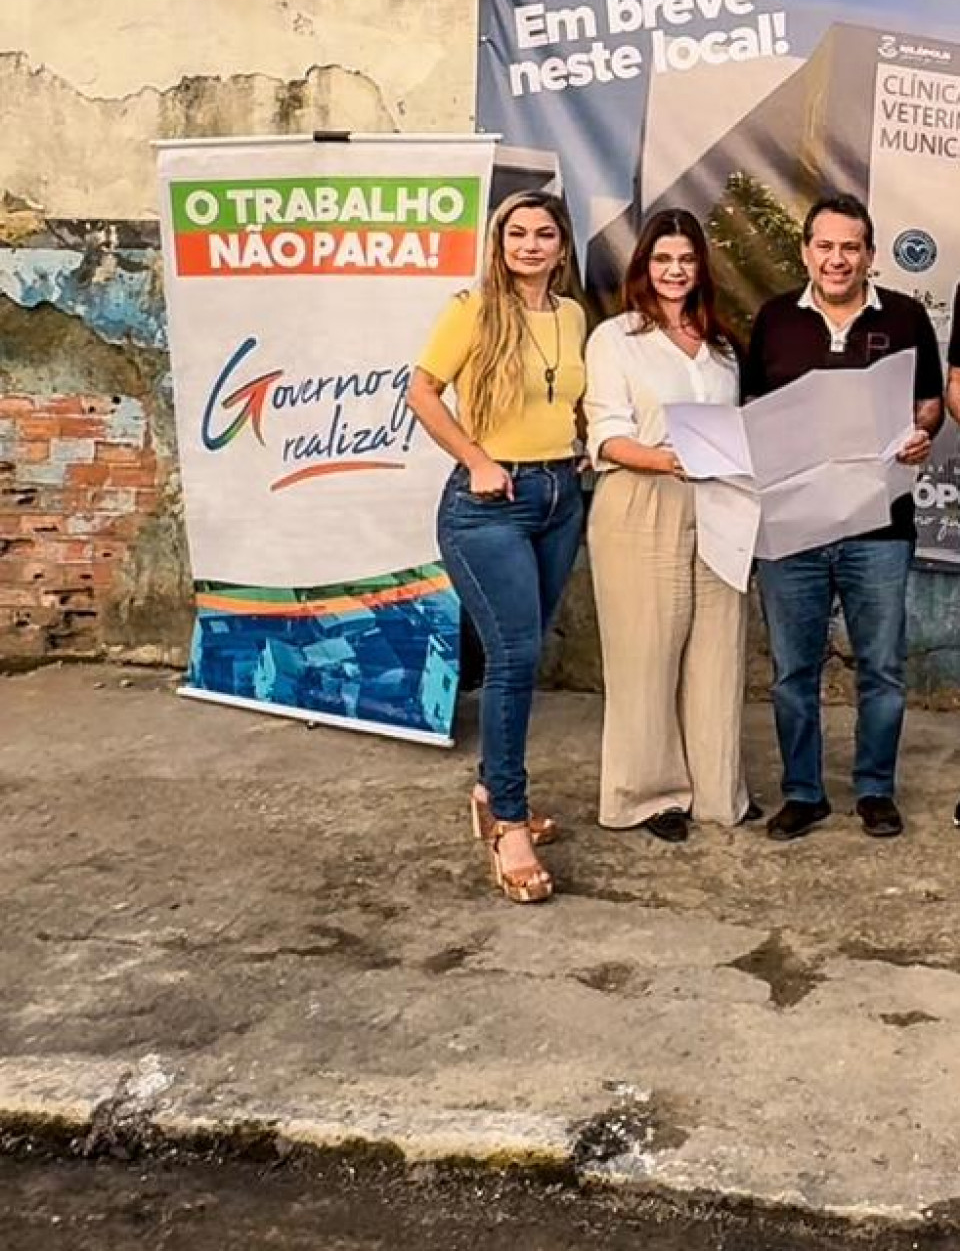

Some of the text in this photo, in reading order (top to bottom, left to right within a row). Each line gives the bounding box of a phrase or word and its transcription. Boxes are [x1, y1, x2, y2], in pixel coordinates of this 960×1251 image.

[514, 3, 597, 48] Em
[509, 12, 790, 97] neste local!
[185, 186, 465, 225] O TRABALHO
[208, 224, 440, 269] NÃO PARA!
[201, 337, 392, 451] Governo
[283, 404, 416, 462] realiza!
